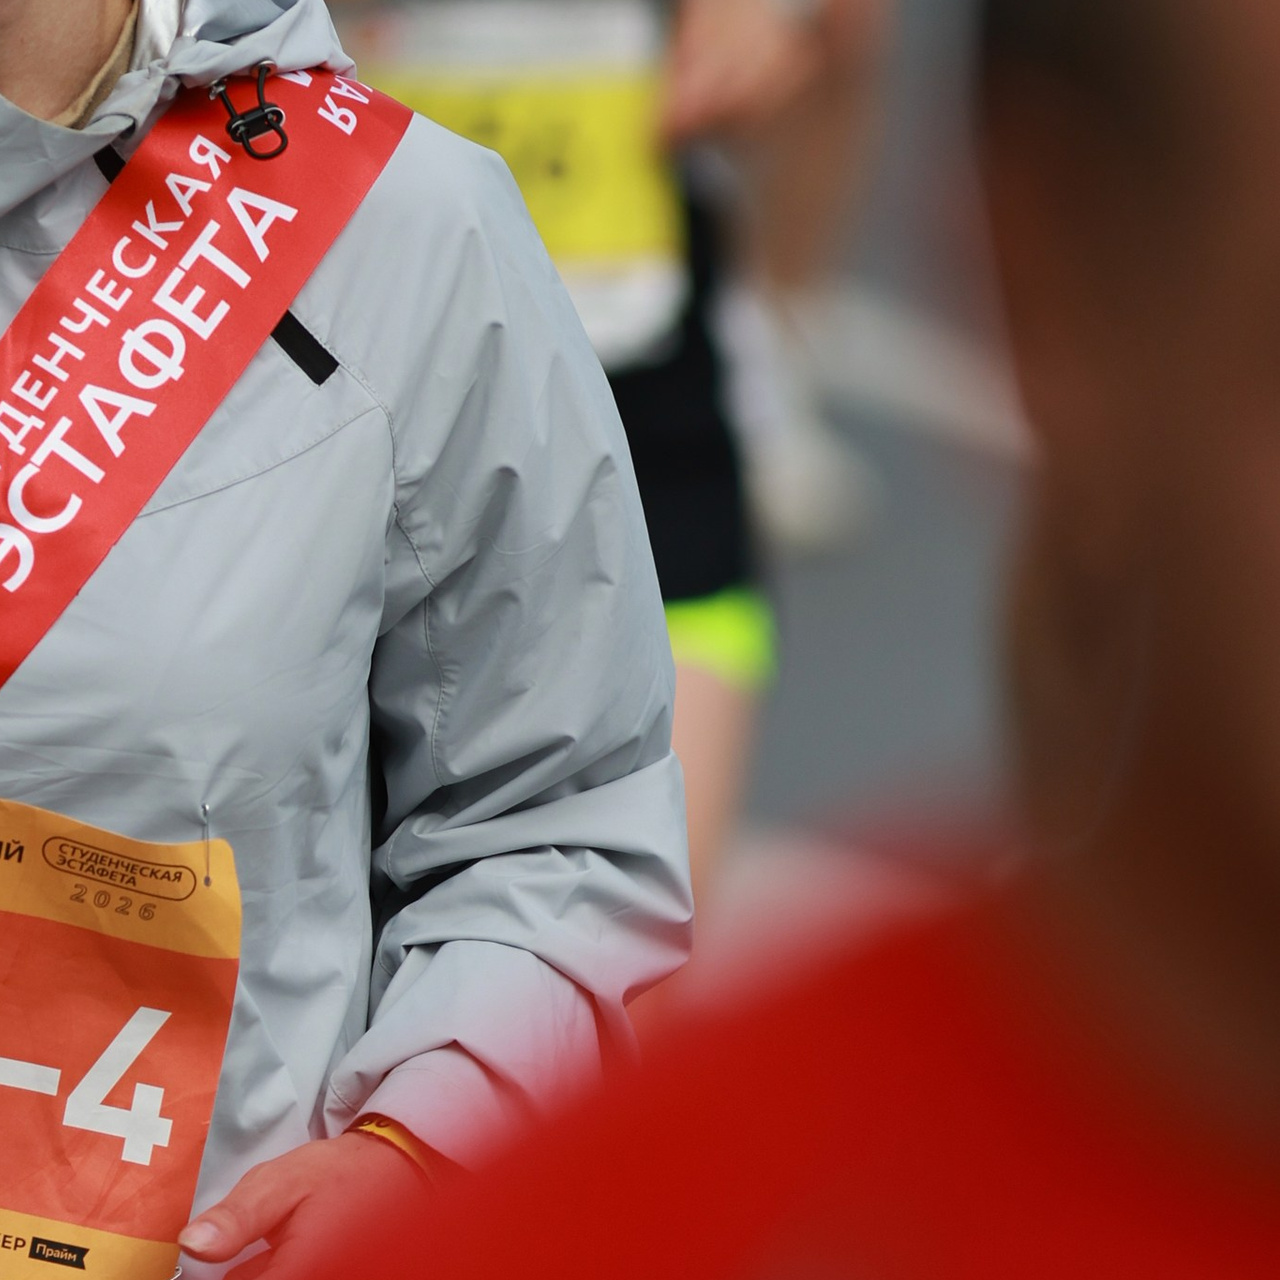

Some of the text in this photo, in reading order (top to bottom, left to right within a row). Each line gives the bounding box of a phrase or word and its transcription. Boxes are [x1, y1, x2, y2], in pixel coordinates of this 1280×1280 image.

[56, 854, 137, 887] ЭСТАФЕТА
[58, 843, 183, 883] СТУДЕНЧЕСКАЯ
[70, 883, 157, 921] 2026
[35, 1243, 78, 1262] Прайм
